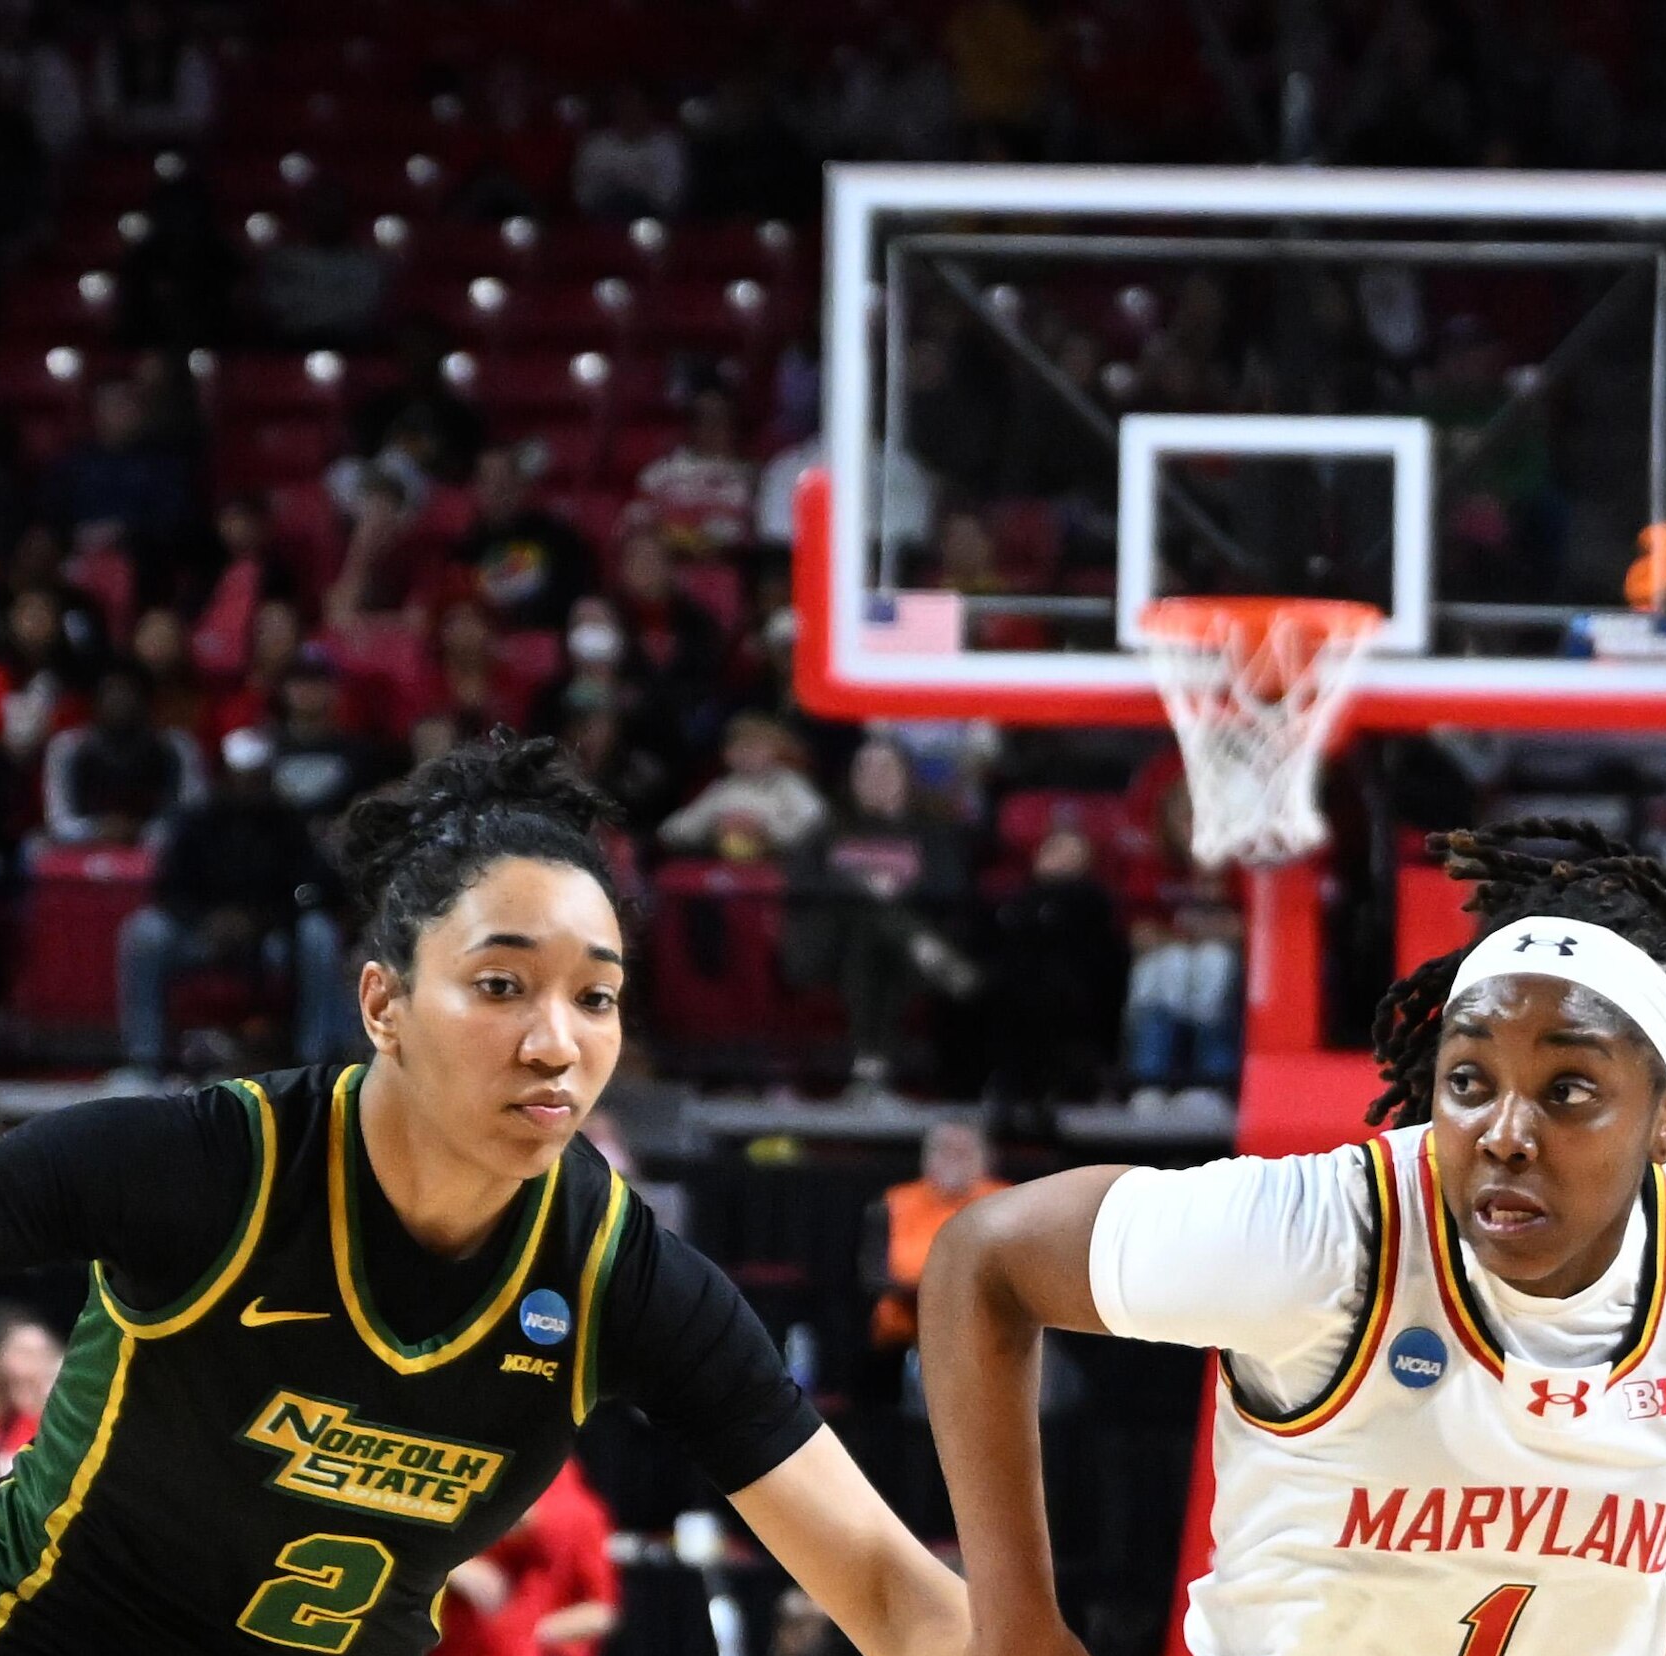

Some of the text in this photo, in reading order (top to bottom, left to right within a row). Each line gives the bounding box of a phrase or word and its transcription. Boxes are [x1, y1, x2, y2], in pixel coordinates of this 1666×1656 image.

[499, 1353, 559, 1377] MEAC
[1394, 1354, 1442, 1377] NCAA
[264, 1402, 488, 1480] NORFOLK
[290, 1452, 468, 1505] STATE
[343, 1485, 455, 1516] SPARTANS
[235, 1532, 394, 1655] 2
